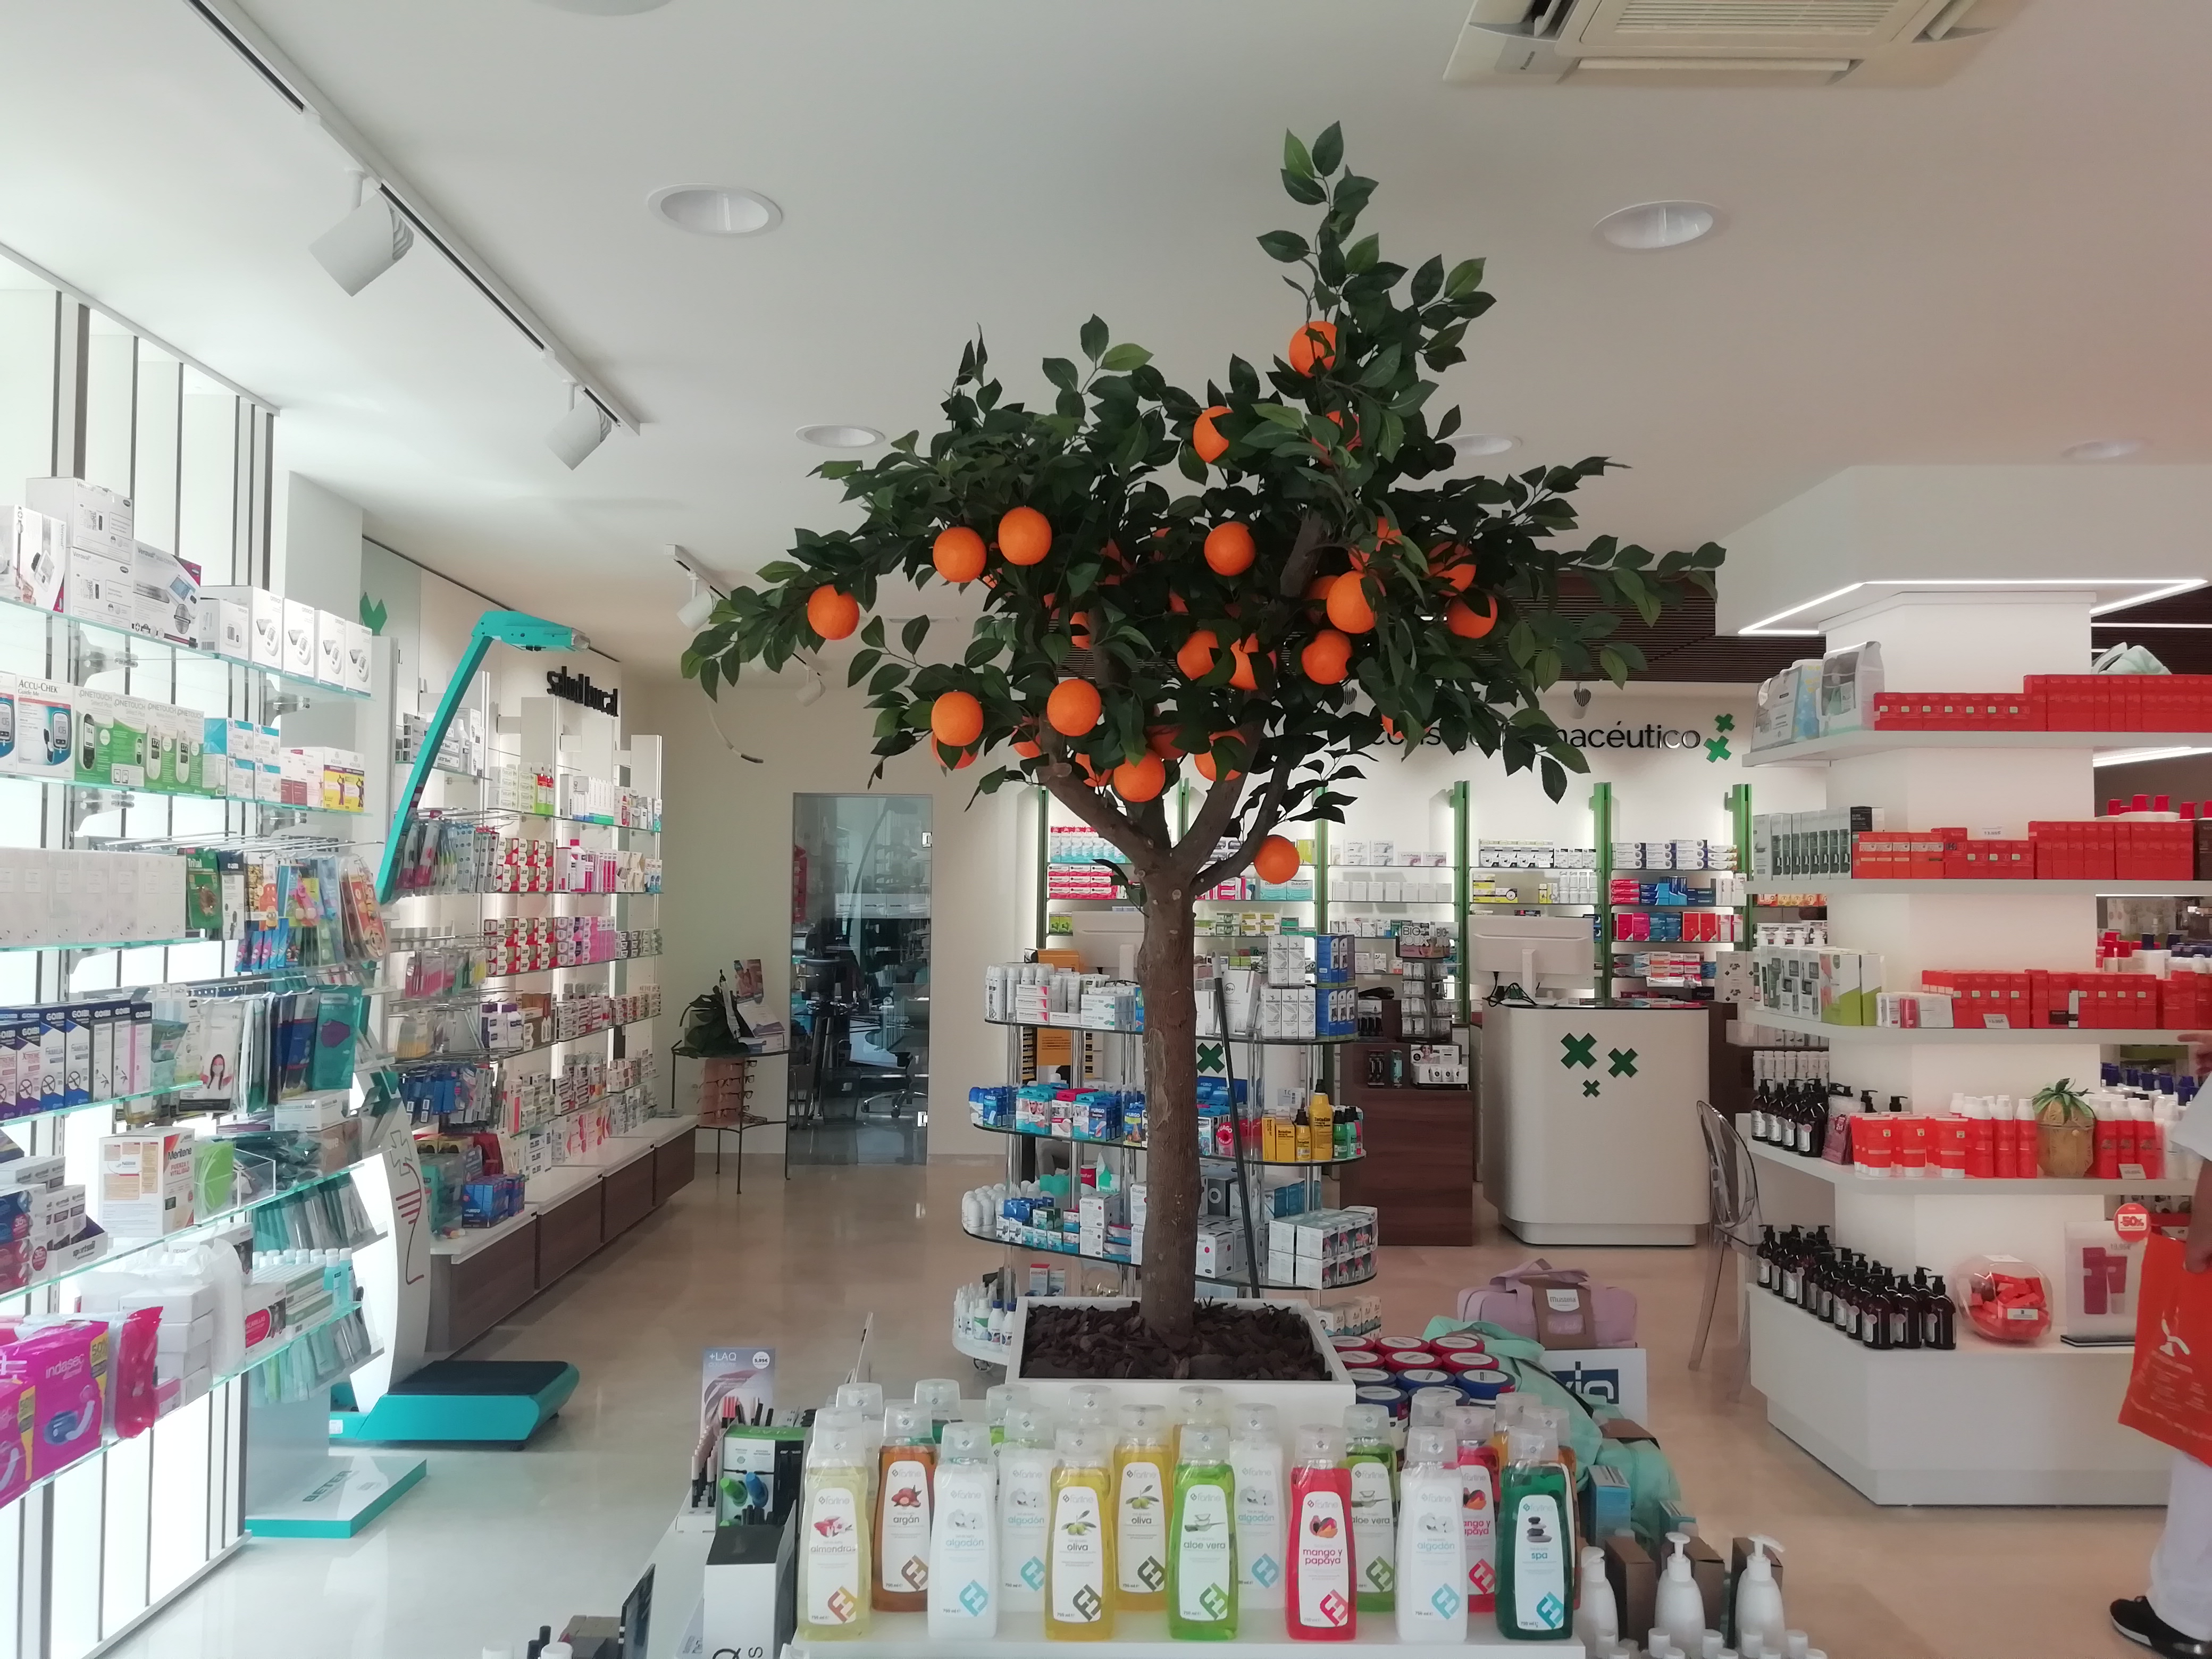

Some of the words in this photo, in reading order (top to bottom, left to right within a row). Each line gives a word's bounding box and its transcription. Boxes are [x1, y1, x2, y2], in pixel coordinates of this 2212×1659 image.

[18, 679, 60, 694] ACCU-CHEK
[114, 699, 146, 710] ONETOUCH
[1403, 927, 1420, 936] BIO
[167, 1146, 192, 1161] Meritene
[709, 1352, 737, 1362] +LAQ
[46, 1354, 85, 1379] indasec
[893, 1514, 920, 1526] argán
[1008, 1515, 1045, 1526] algodón
[1132, 1516, 1152, 1525] oliva
[1238, 1513, 1275, 1523] algodón
[1464, 1520, 1484, 1530] ango
[1463, 1527, 1489, 1536] paya
[945, 1538, 984, 1548] algodón
[1067, 1543, 1088, 1552] oliva
[1183, 1540, 1203, 1549] aloe
[1417, 1540, 1455, 1550] algodón
[810, 1544, 857, 1554] almendras
[1303, 1548, 1335, 1559] mango
[1337, 1548, 1343, 1557] y
[1305, 1556, 1341, 1566] papaya
[1531, 1551, 1548, 1561] spa
